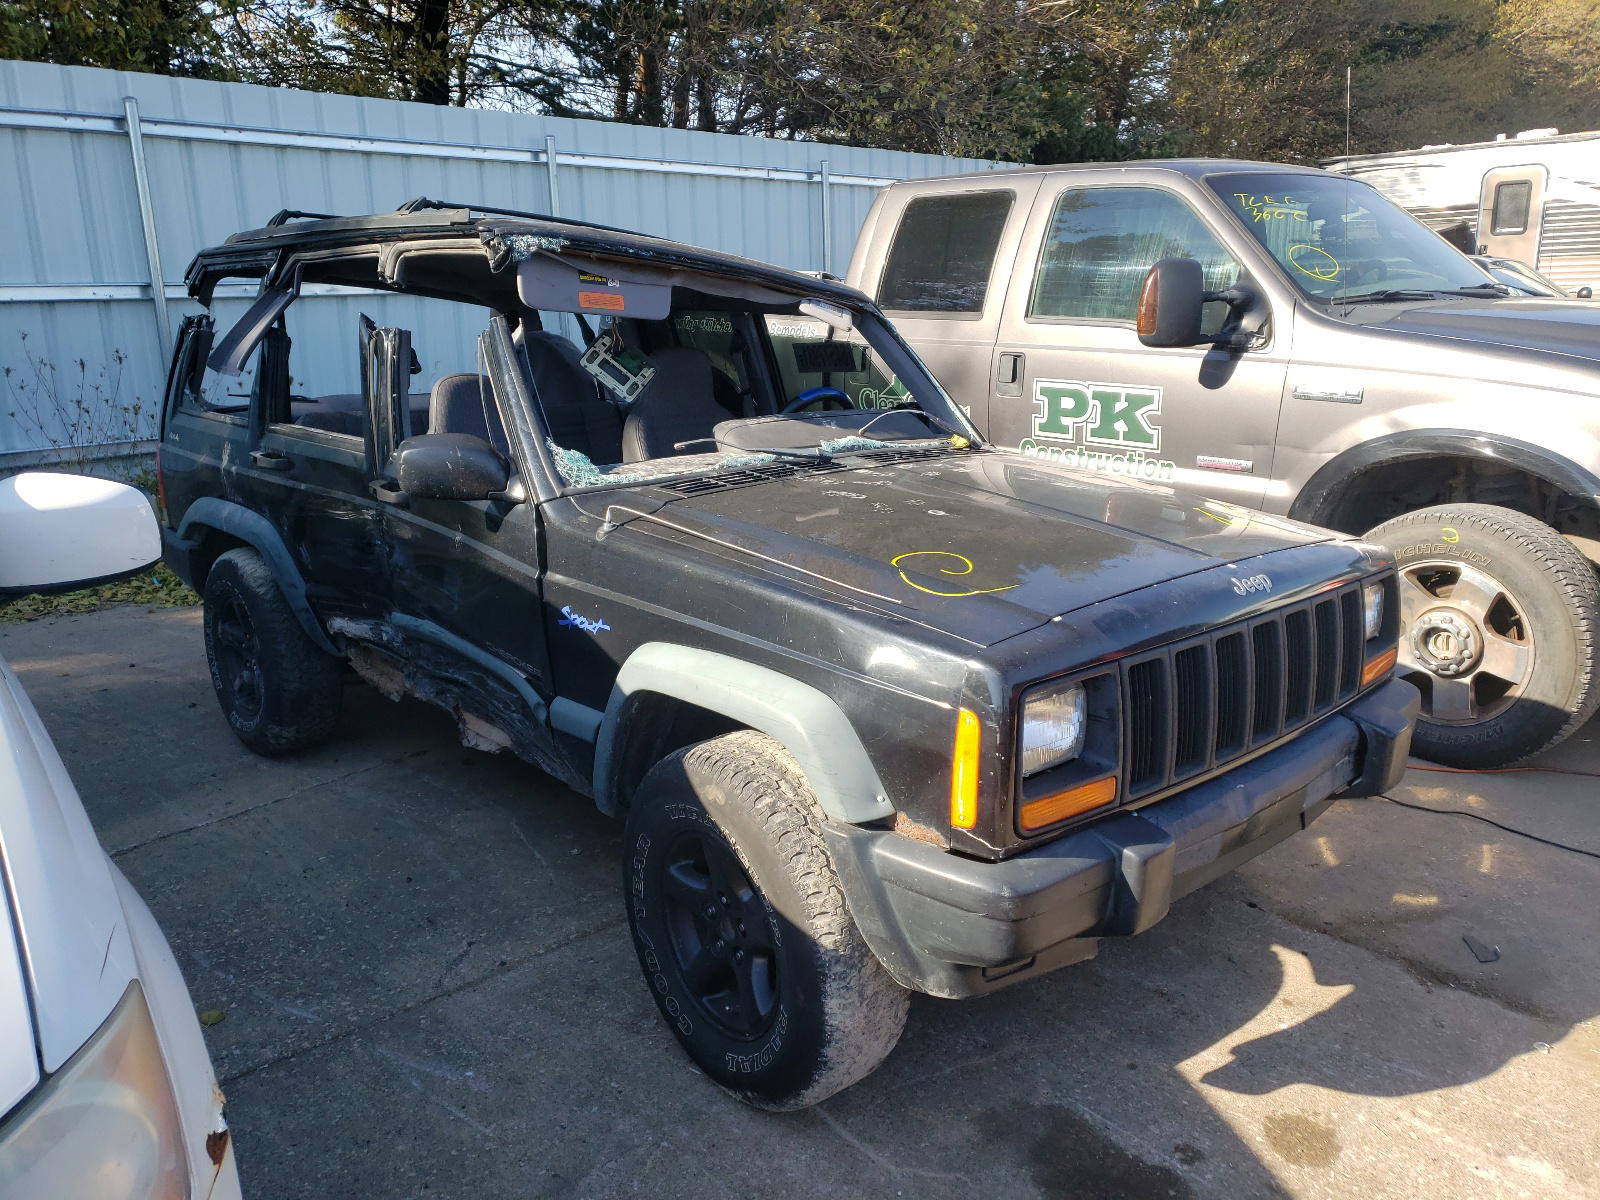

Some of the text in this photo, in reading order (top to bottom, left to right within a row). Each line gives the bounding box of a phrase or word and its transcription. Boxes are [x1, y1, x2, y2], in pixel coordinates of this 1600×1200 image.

[1033, 378, 1163, 453] PK
[1018, 438, 1176, 480] Construction
[1394, 543, 1492, 567] ICHELIN
[1231, 574, 1273, 596] Jeep
